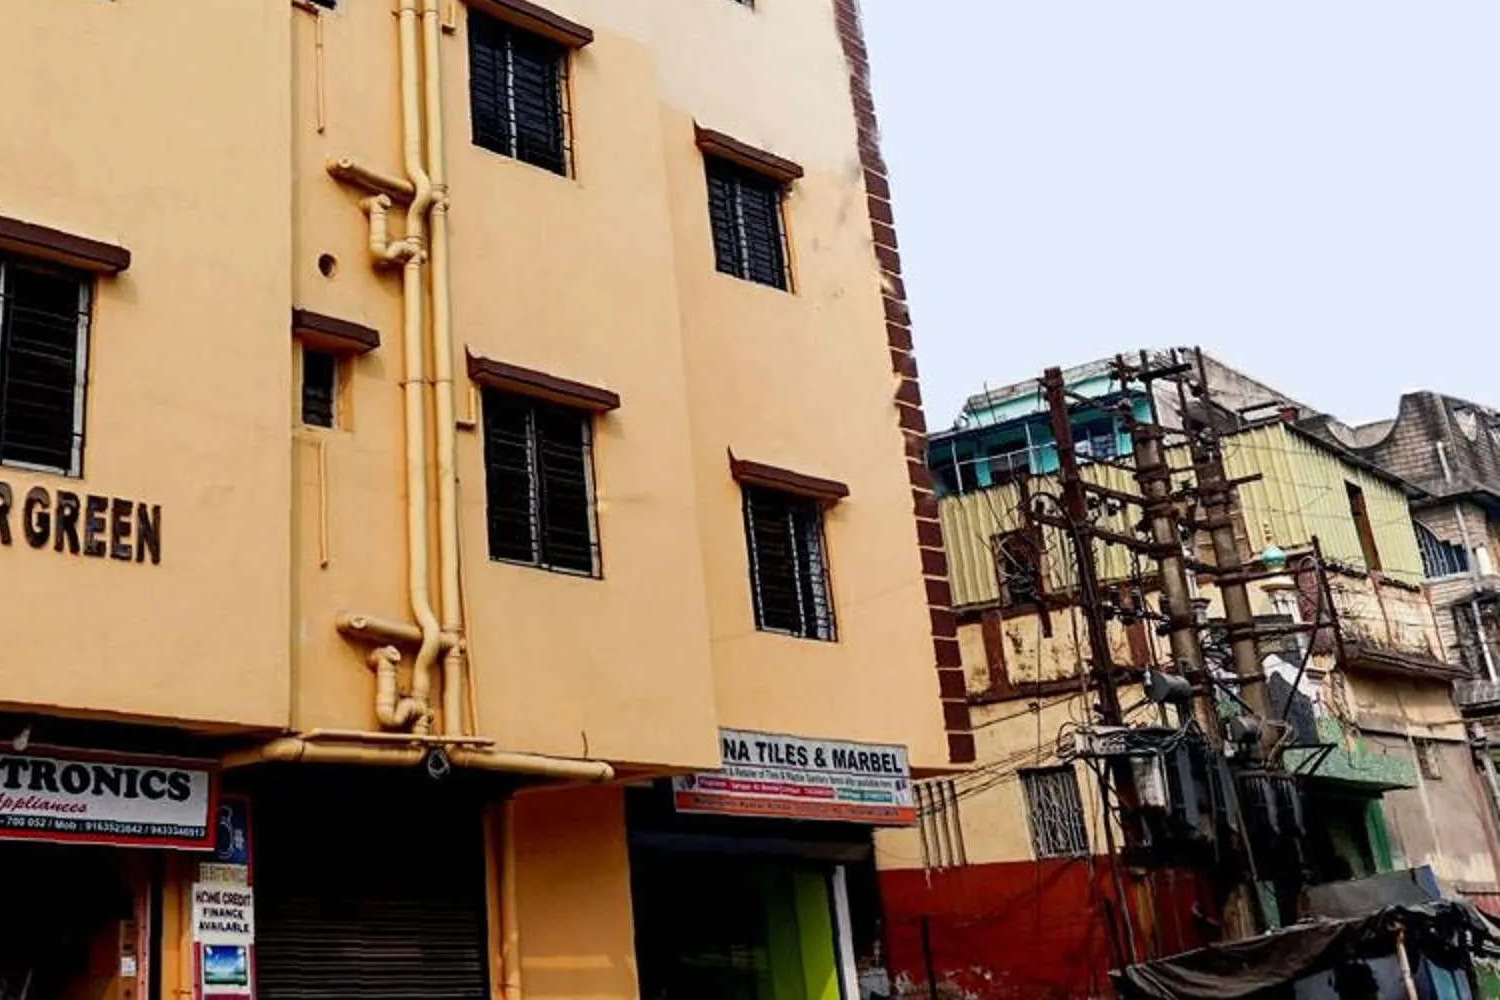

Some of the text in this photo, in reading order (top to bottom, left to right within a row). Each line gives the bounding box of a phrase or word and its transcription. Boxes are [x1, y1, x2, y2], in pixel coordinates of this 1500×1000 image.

[23, 486, 162, 566] GREEN
[754, 741, 808, 767] TILES
[814, 747, 827, 768] &
[832, 749, 903, 773] MARBEL
[196, 889, 251, 906] HOME CREDIT
[203, 907, 244, 920] FINANCE
[199, 920, 250, 933] AVAILABLE
